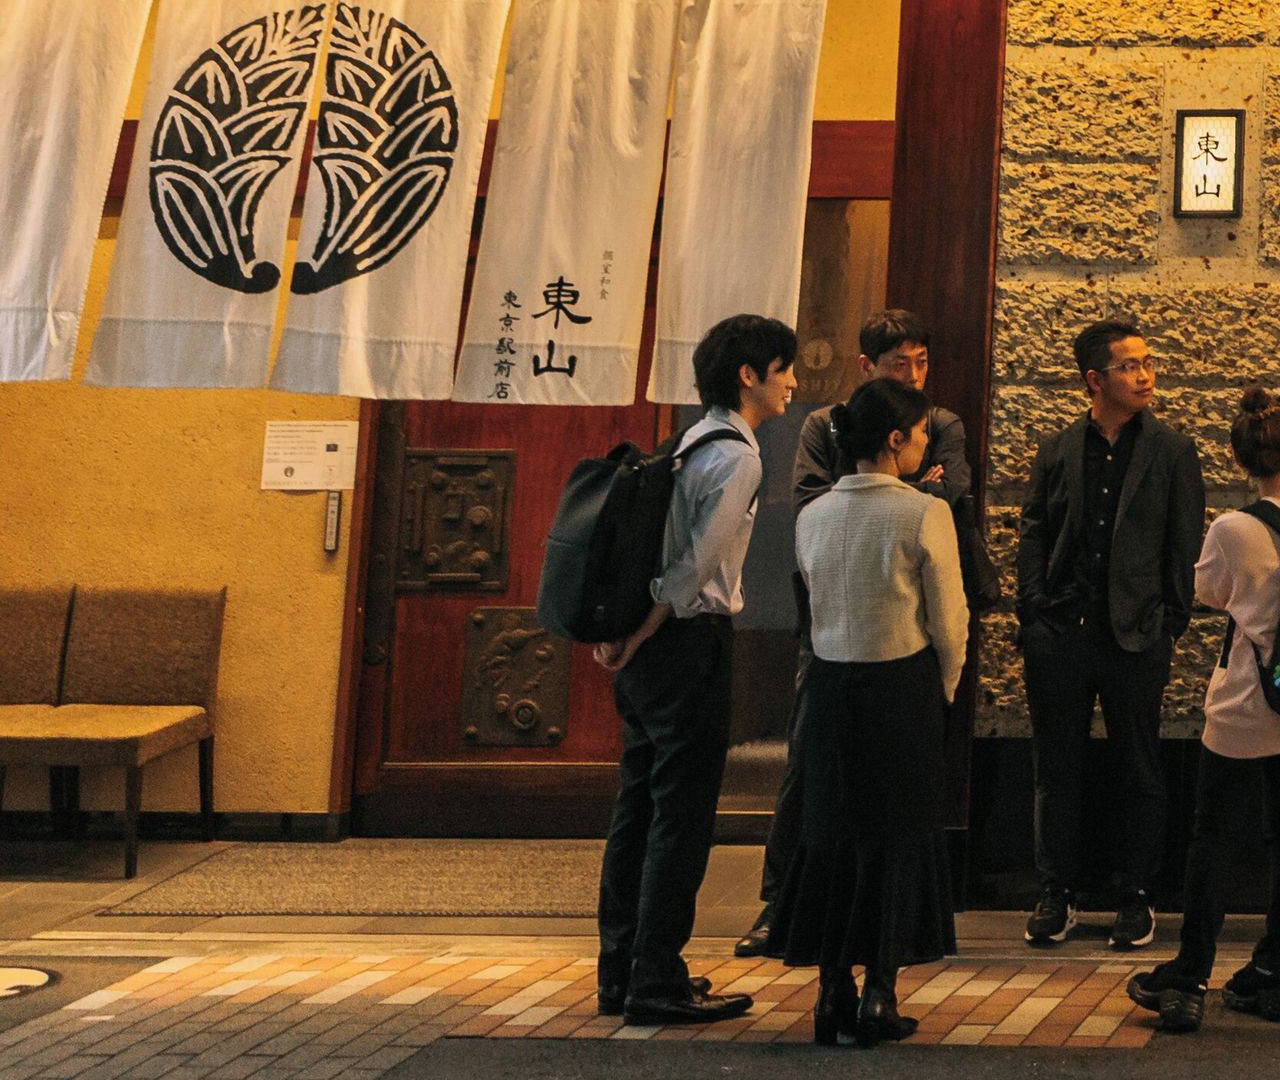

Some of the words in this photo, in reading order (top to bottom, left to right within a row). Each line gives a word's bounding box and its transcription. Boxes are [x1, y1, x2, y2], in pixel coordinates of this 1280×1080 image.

[1192, 131, 1228, 198] 東山
[487, 289, 522, 400] 東京駅前店
[531, 275, 593, 378] 東山
